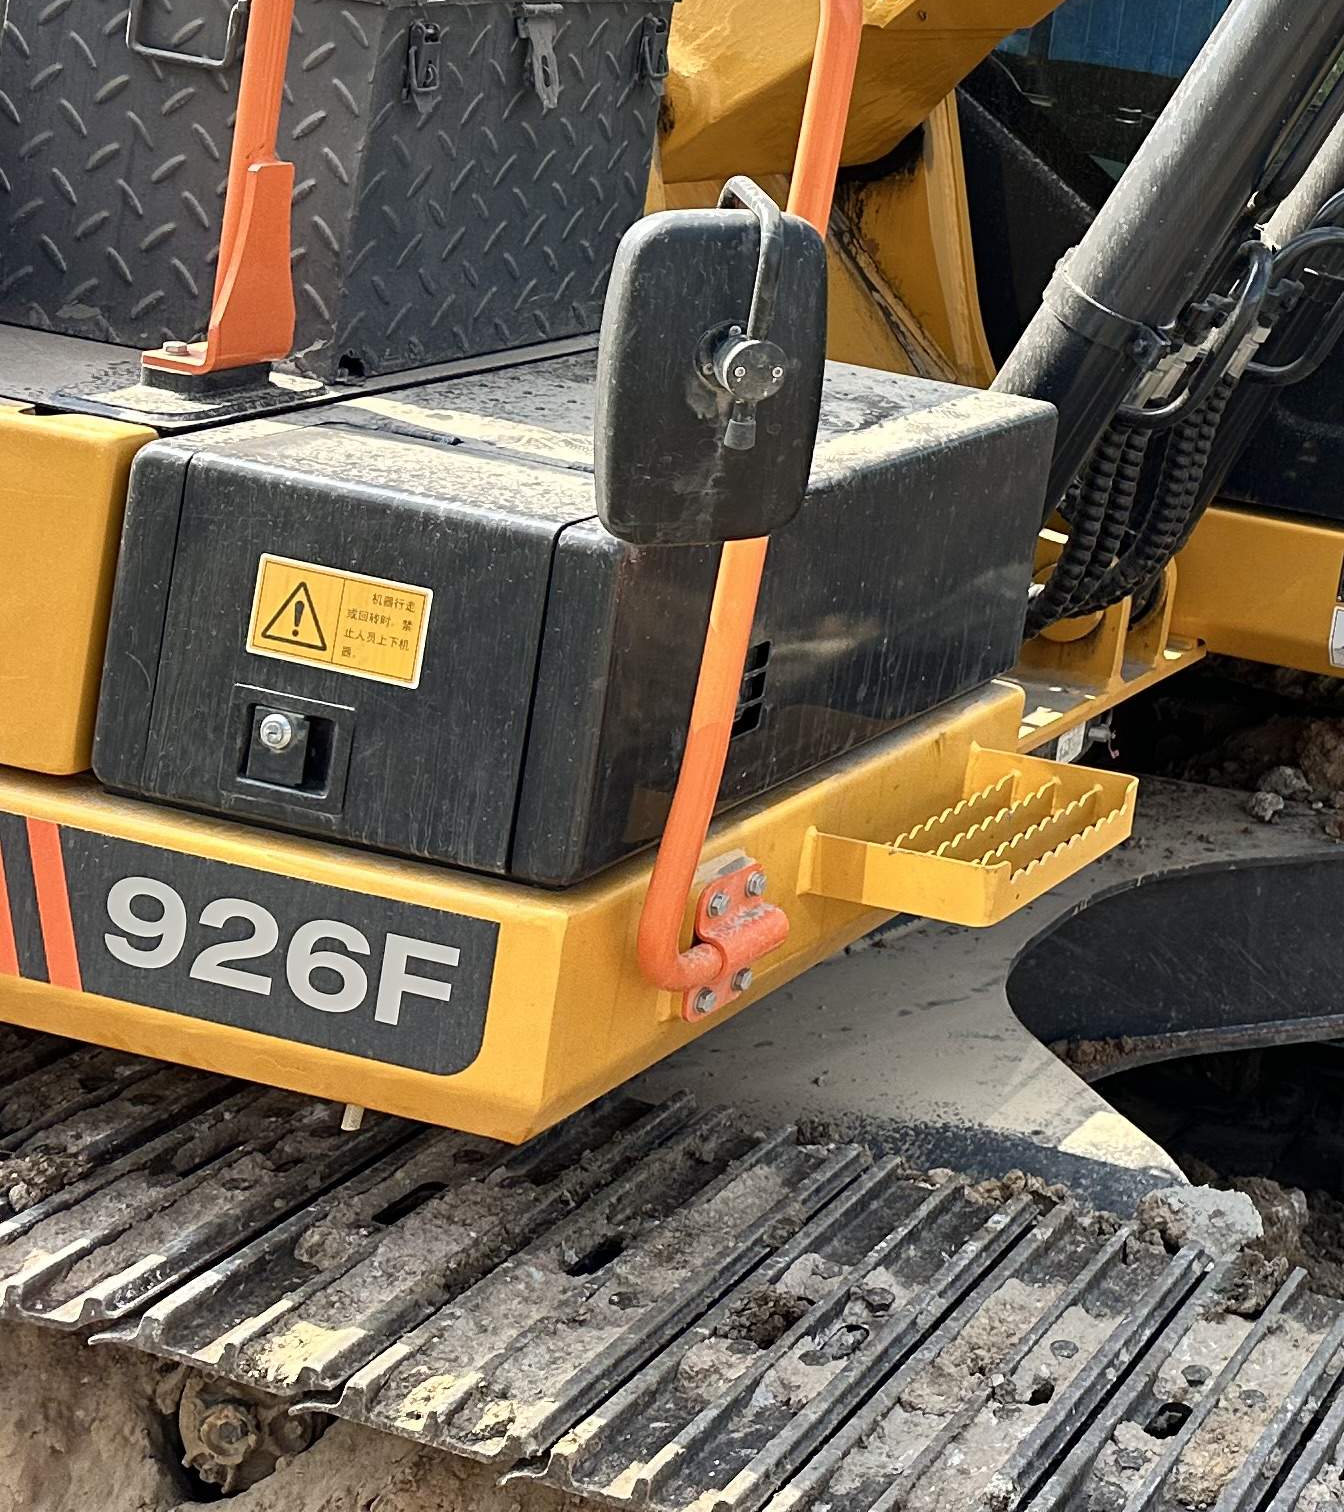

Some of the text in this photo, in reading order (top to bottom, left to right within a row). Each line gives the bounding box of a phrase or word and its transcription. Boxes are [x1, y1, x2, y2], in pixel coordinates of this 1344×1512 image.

[372, 593, 415, 613] 机器行走
[344, 628, 409, 651] 止人员上下机
[103, 876, 461, 1026] 926F
